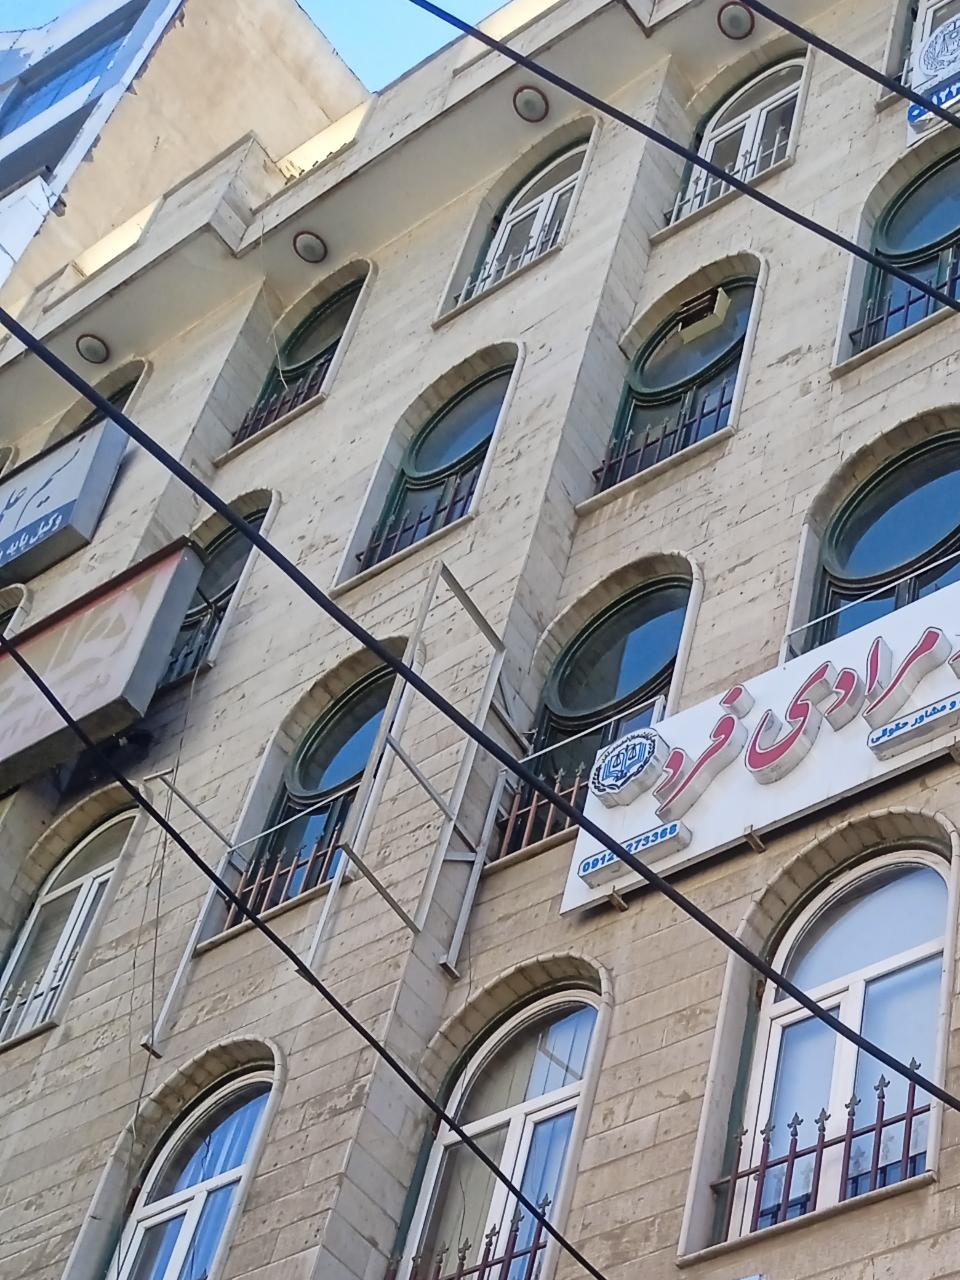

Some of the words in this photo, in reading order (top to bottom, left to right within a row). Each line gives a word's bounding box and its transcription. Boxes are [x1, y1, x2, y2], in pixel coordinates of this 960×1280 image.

[745, 626, 945, 772] مرادی
[911, 703, 947, 728] مشاور
[651, 683, 745, 817] فرد
[870, 720, 909, 744] حقوقی
[581, 822, 679, 874] 0912273368
